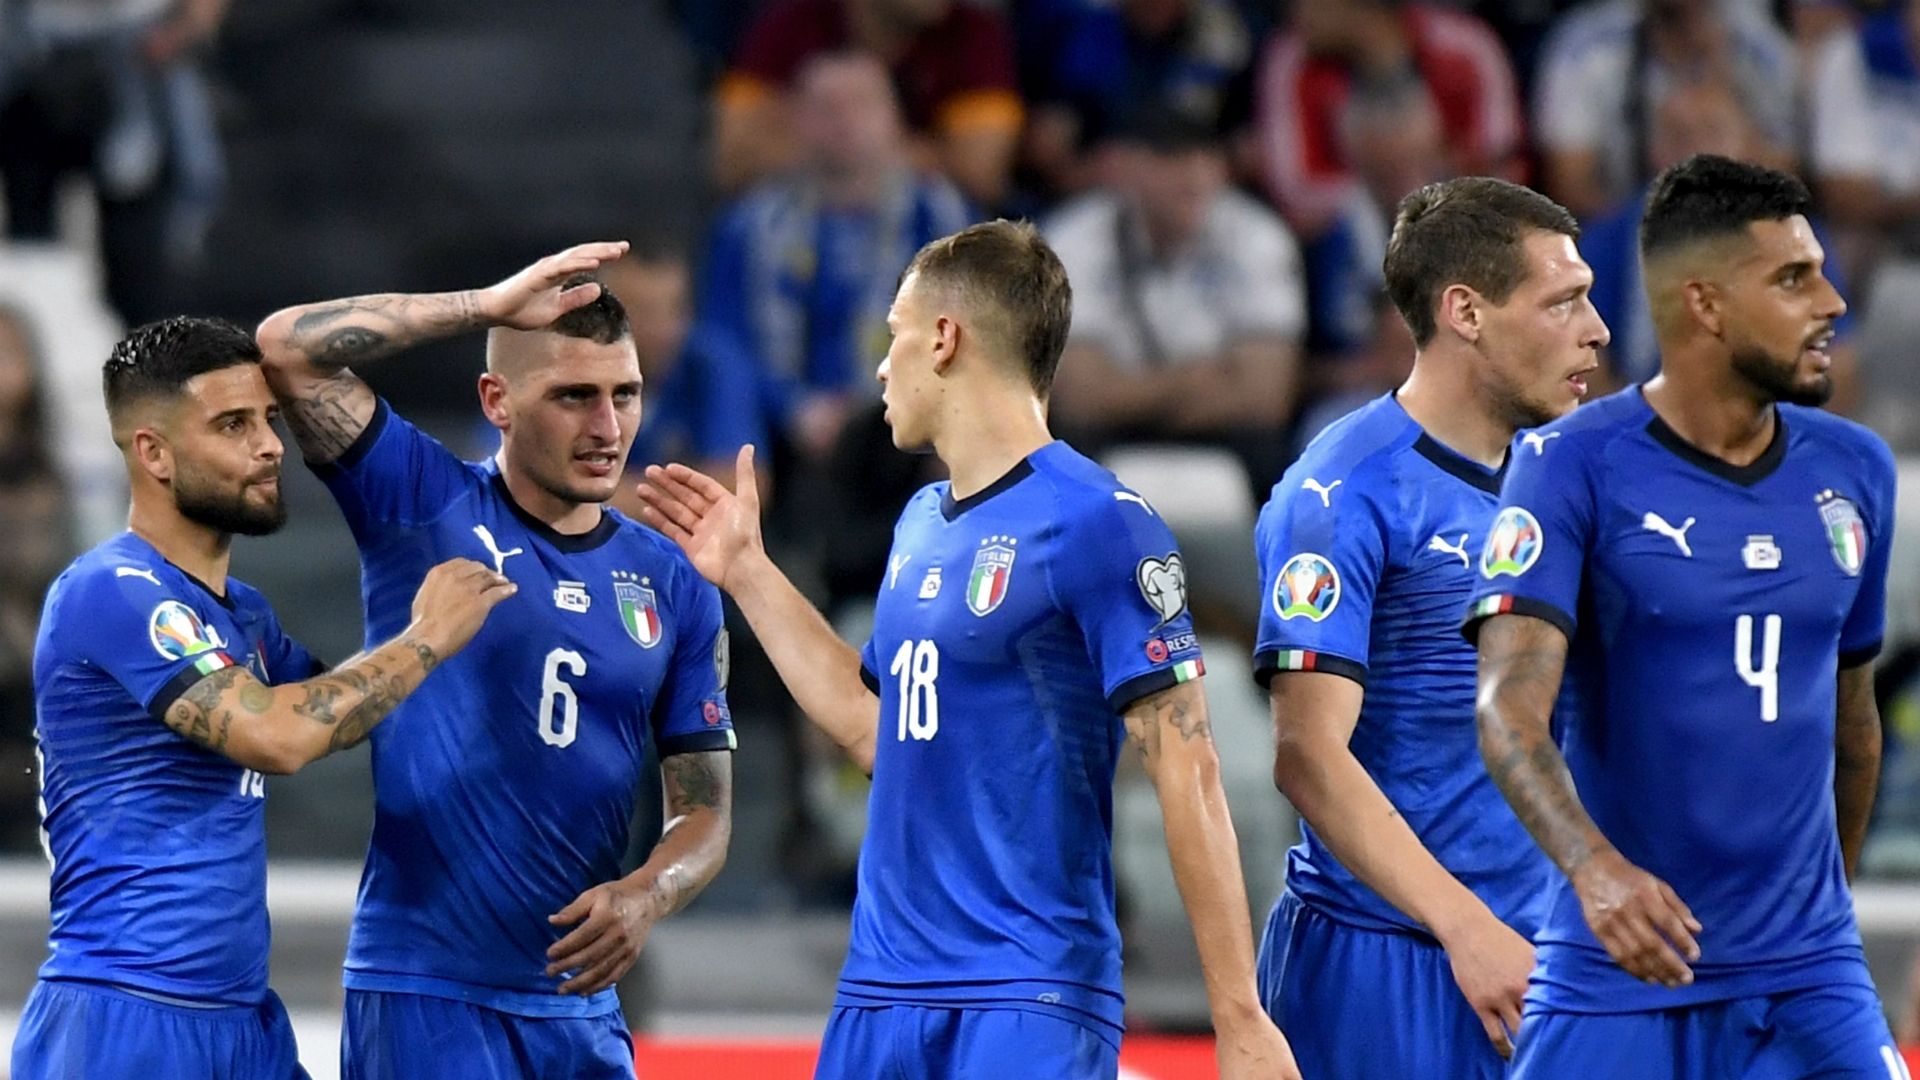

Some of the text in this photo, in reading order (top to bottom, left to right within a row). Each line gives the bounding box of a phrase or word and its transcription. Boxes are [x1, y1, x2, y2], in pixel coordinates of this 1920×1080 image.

[538, 647, 587, 748] 6
[890, 639, 939, 742] 18
[1734, 613, 1782, 722] 4
